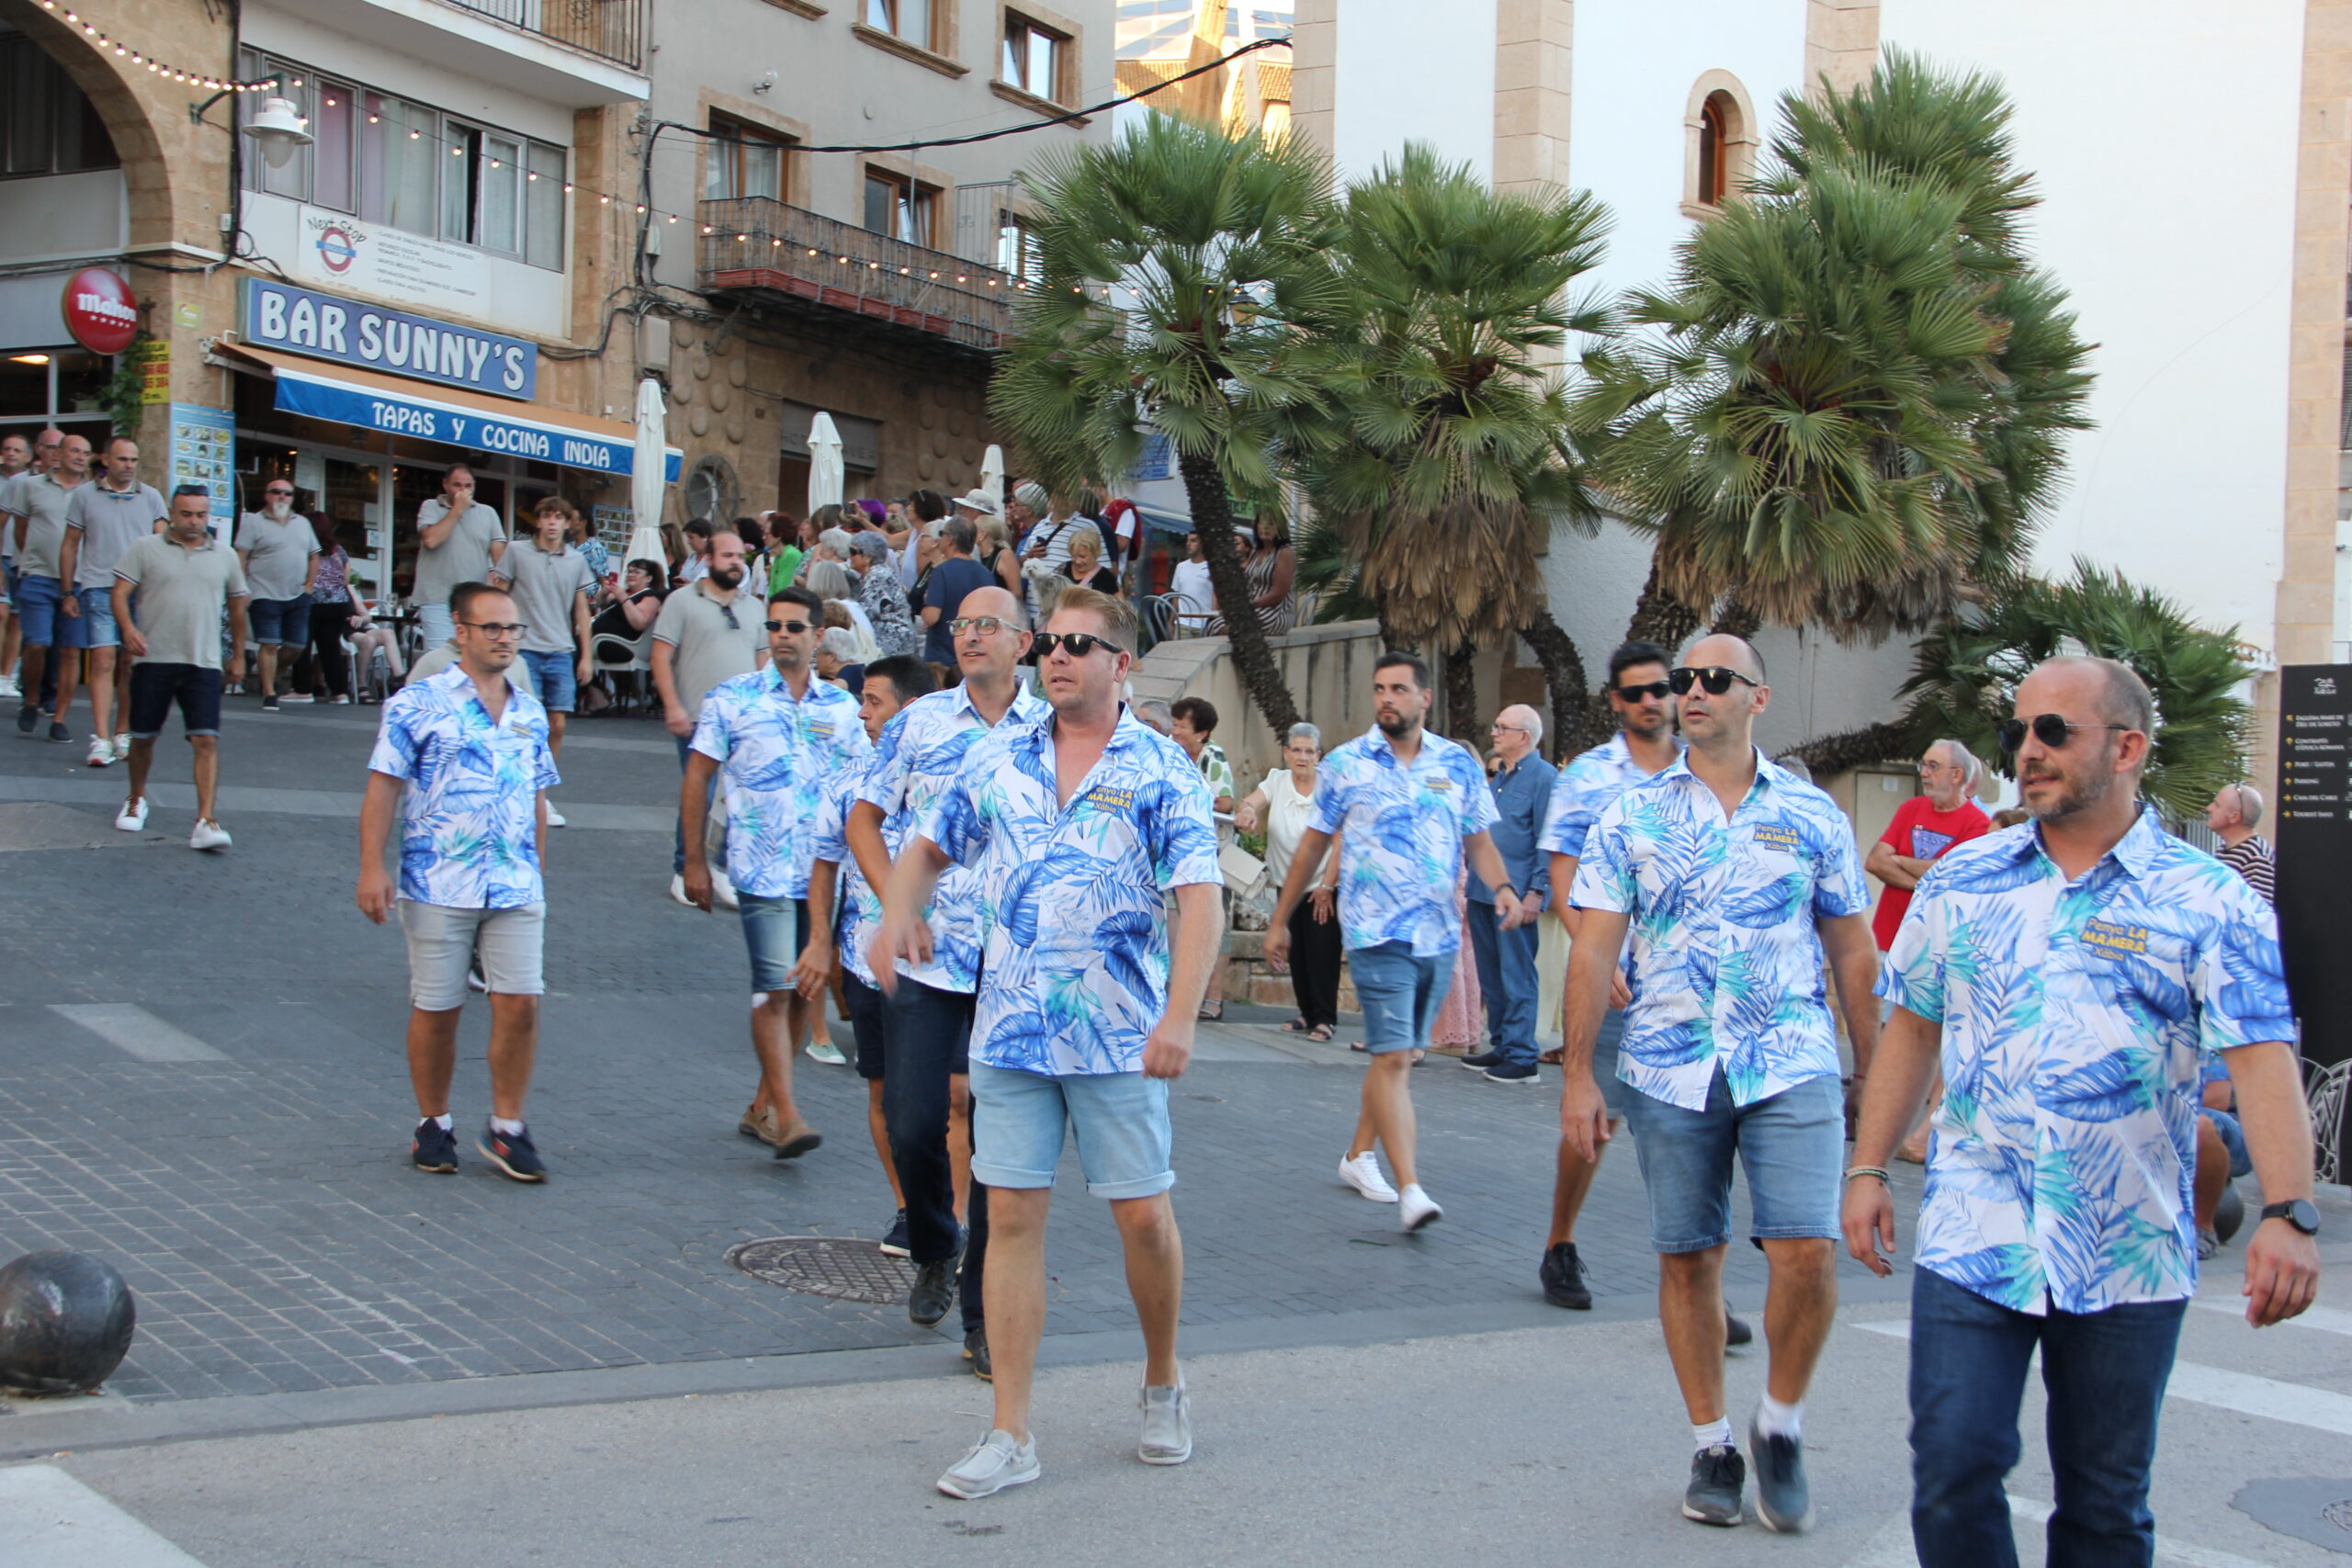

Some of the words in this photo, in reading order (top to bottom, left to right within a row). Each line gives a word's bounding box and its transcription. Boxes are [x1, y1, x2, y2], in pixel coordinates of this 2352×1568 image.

[307, 217, 334, 230] Next
[340, 220, 367, 244] Stop
[259, 289, 347, 355] BAR
[358, 313, 526, 391] SUNNY'S
[372, 401, 435, 436] TAPAS
[451, 417, 466, 441] Y
[481, 424, 550, 457] COCINA
[564, 440, 610, 469] INDIA
[1119, 790, 1133, 799] LA
[1784, 828, 1798, 836] LA
[2128, 925, 2147, 940] LA
